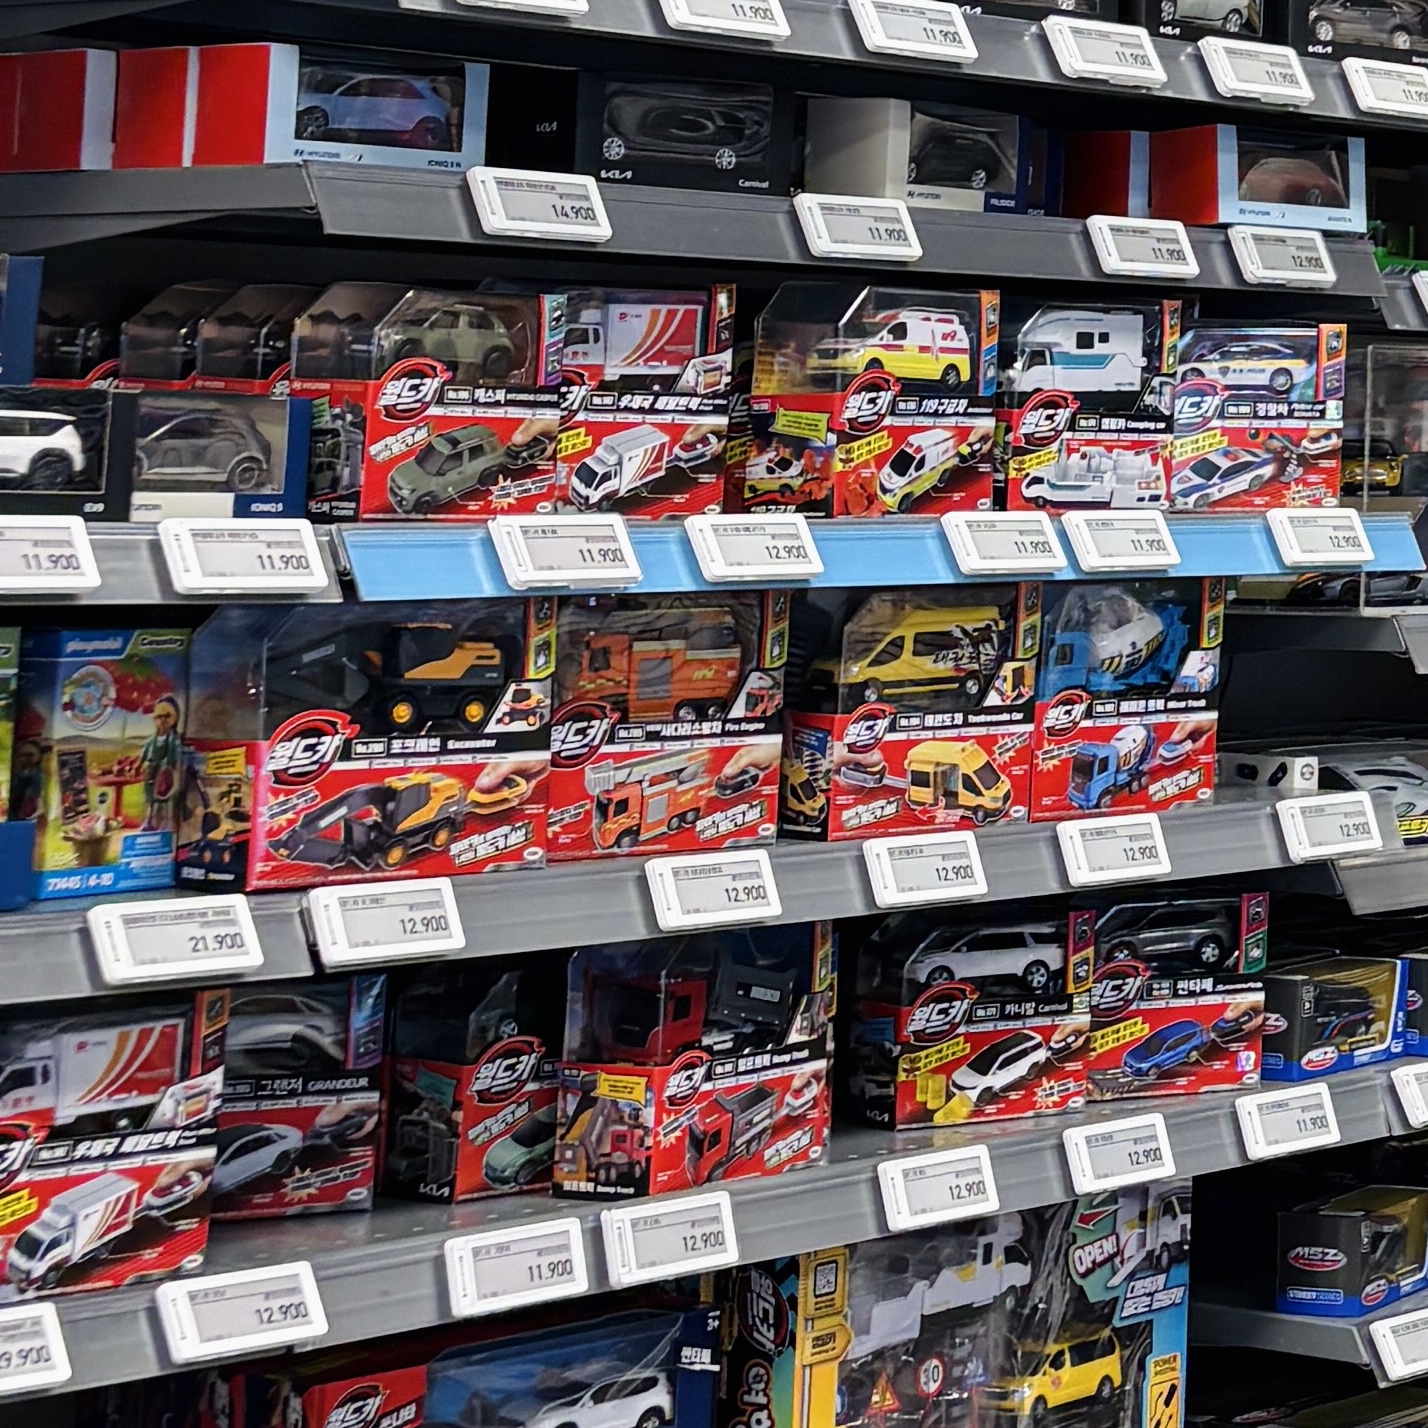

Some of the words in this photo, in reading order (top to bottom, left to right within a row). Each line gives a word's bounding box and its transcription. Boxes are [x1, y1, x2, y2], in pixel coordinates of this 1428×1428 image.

[730, 2, 774, 21] 11.900
[922, 26, 962, 45] 11.900
[551, 202, 597, 223] 14.900
[867, 224, 909, 244] 11.900
[1151, 245, 1186, 264] 11.900
[377, 374, 441, 408] 월드카
[764, 543, 807, 562] 12.900
[1013, 538, 1053, 555] 11.900
[1131, 537, 1168, 554] 11.900
[21, 551, 80, 573] 11.900
[256, 552, 310, 572] 11.900
[1122, 844, 1158, 862] 12.900
[186, 930, 246, 956] 21.900
[307, 1077, 369, 1092] GRANDEUR
[1127, 1146, 1162, 1165] 12.900
[948, 1180, 985, 1200] 12.900
[682, 1230, 725, 1252] 12.900
[1073, 1233, 1118, 1275] OPEN!
[1291, 1246, 1345, 1263] MSZ
[526, 1258, 574, 1283] 11.900
[253, 1300, 309, 1326] 12.900
